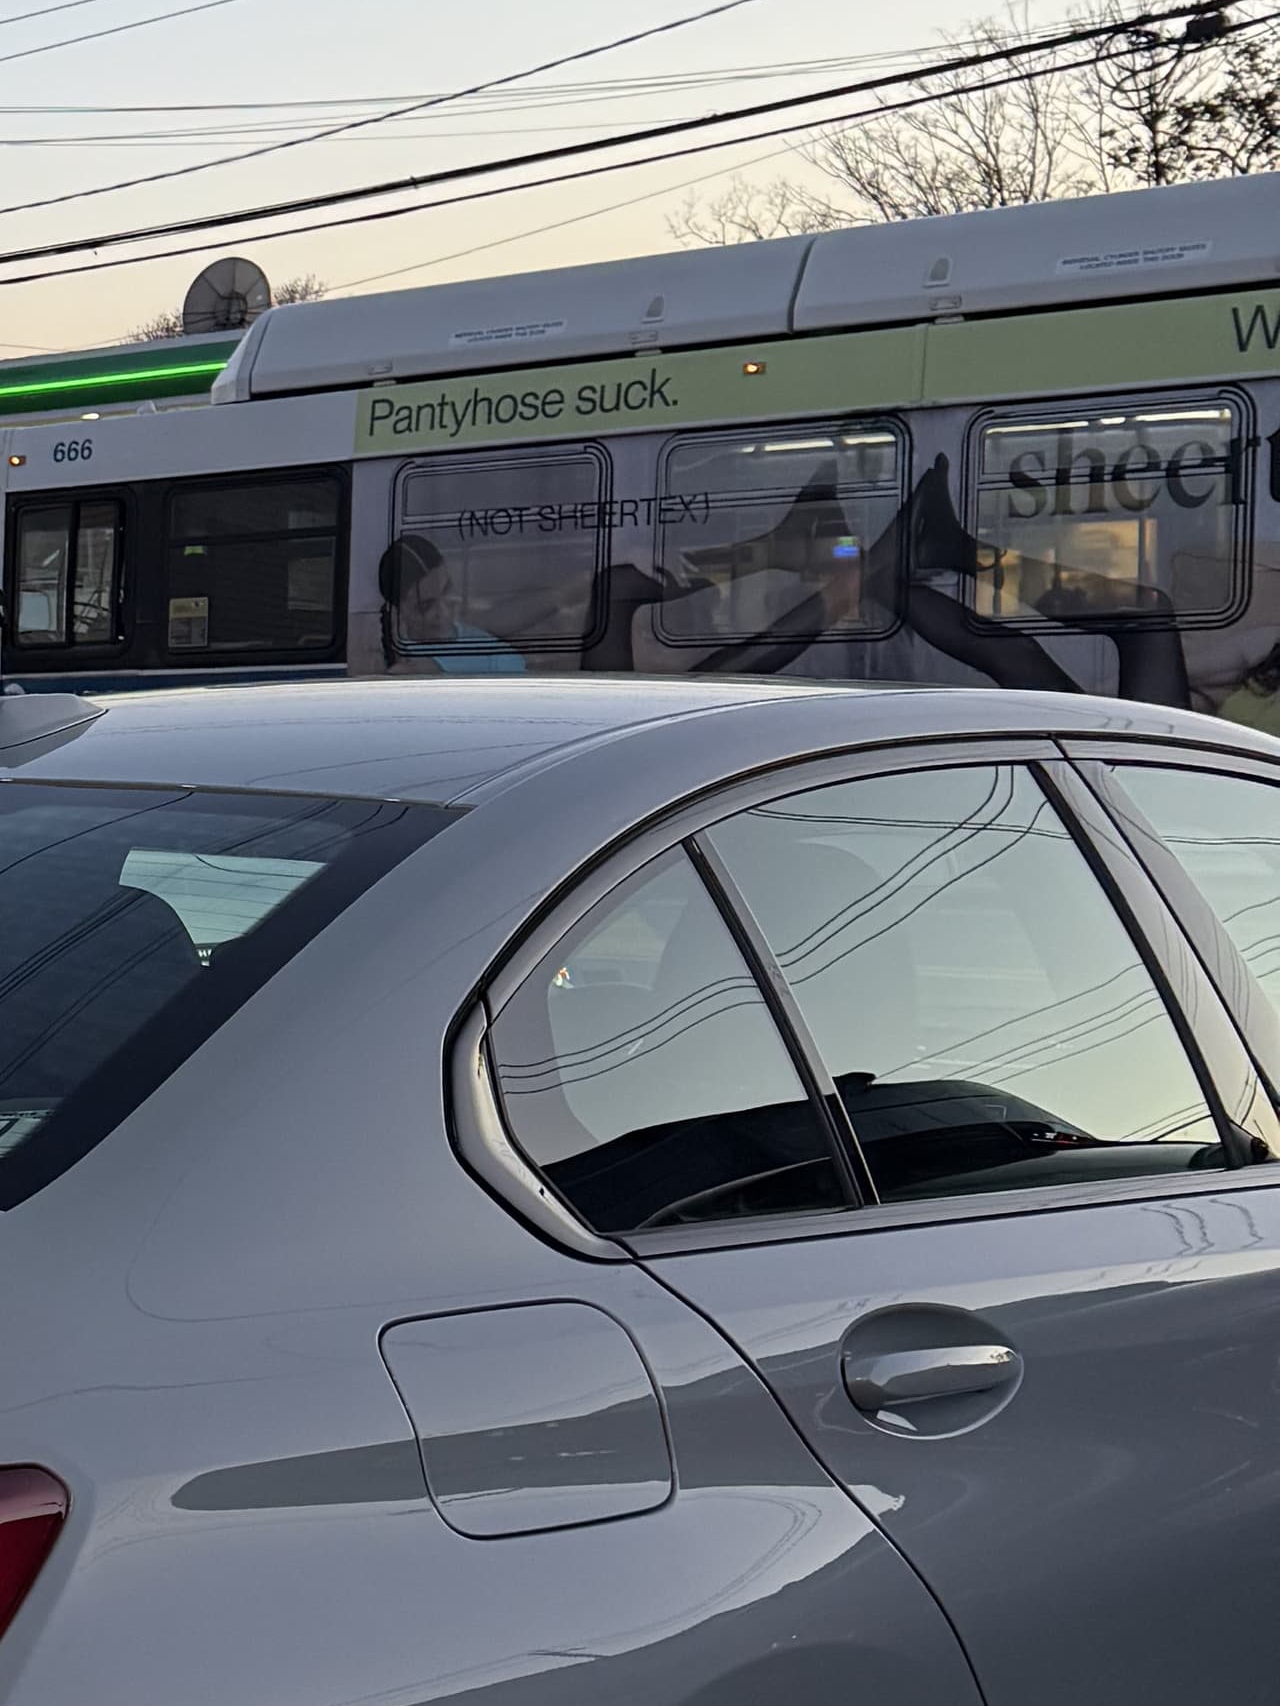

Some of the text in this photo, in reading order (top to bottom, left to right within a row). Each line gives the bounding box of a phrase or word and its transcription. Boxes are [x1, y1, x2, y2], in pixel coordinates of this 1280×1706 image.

[369, 367, 679, 438] Pantyhose suck.
[53, 438, 93, 463] 666
[458, 491, 710, 541] (NOT SHEERTEX)
